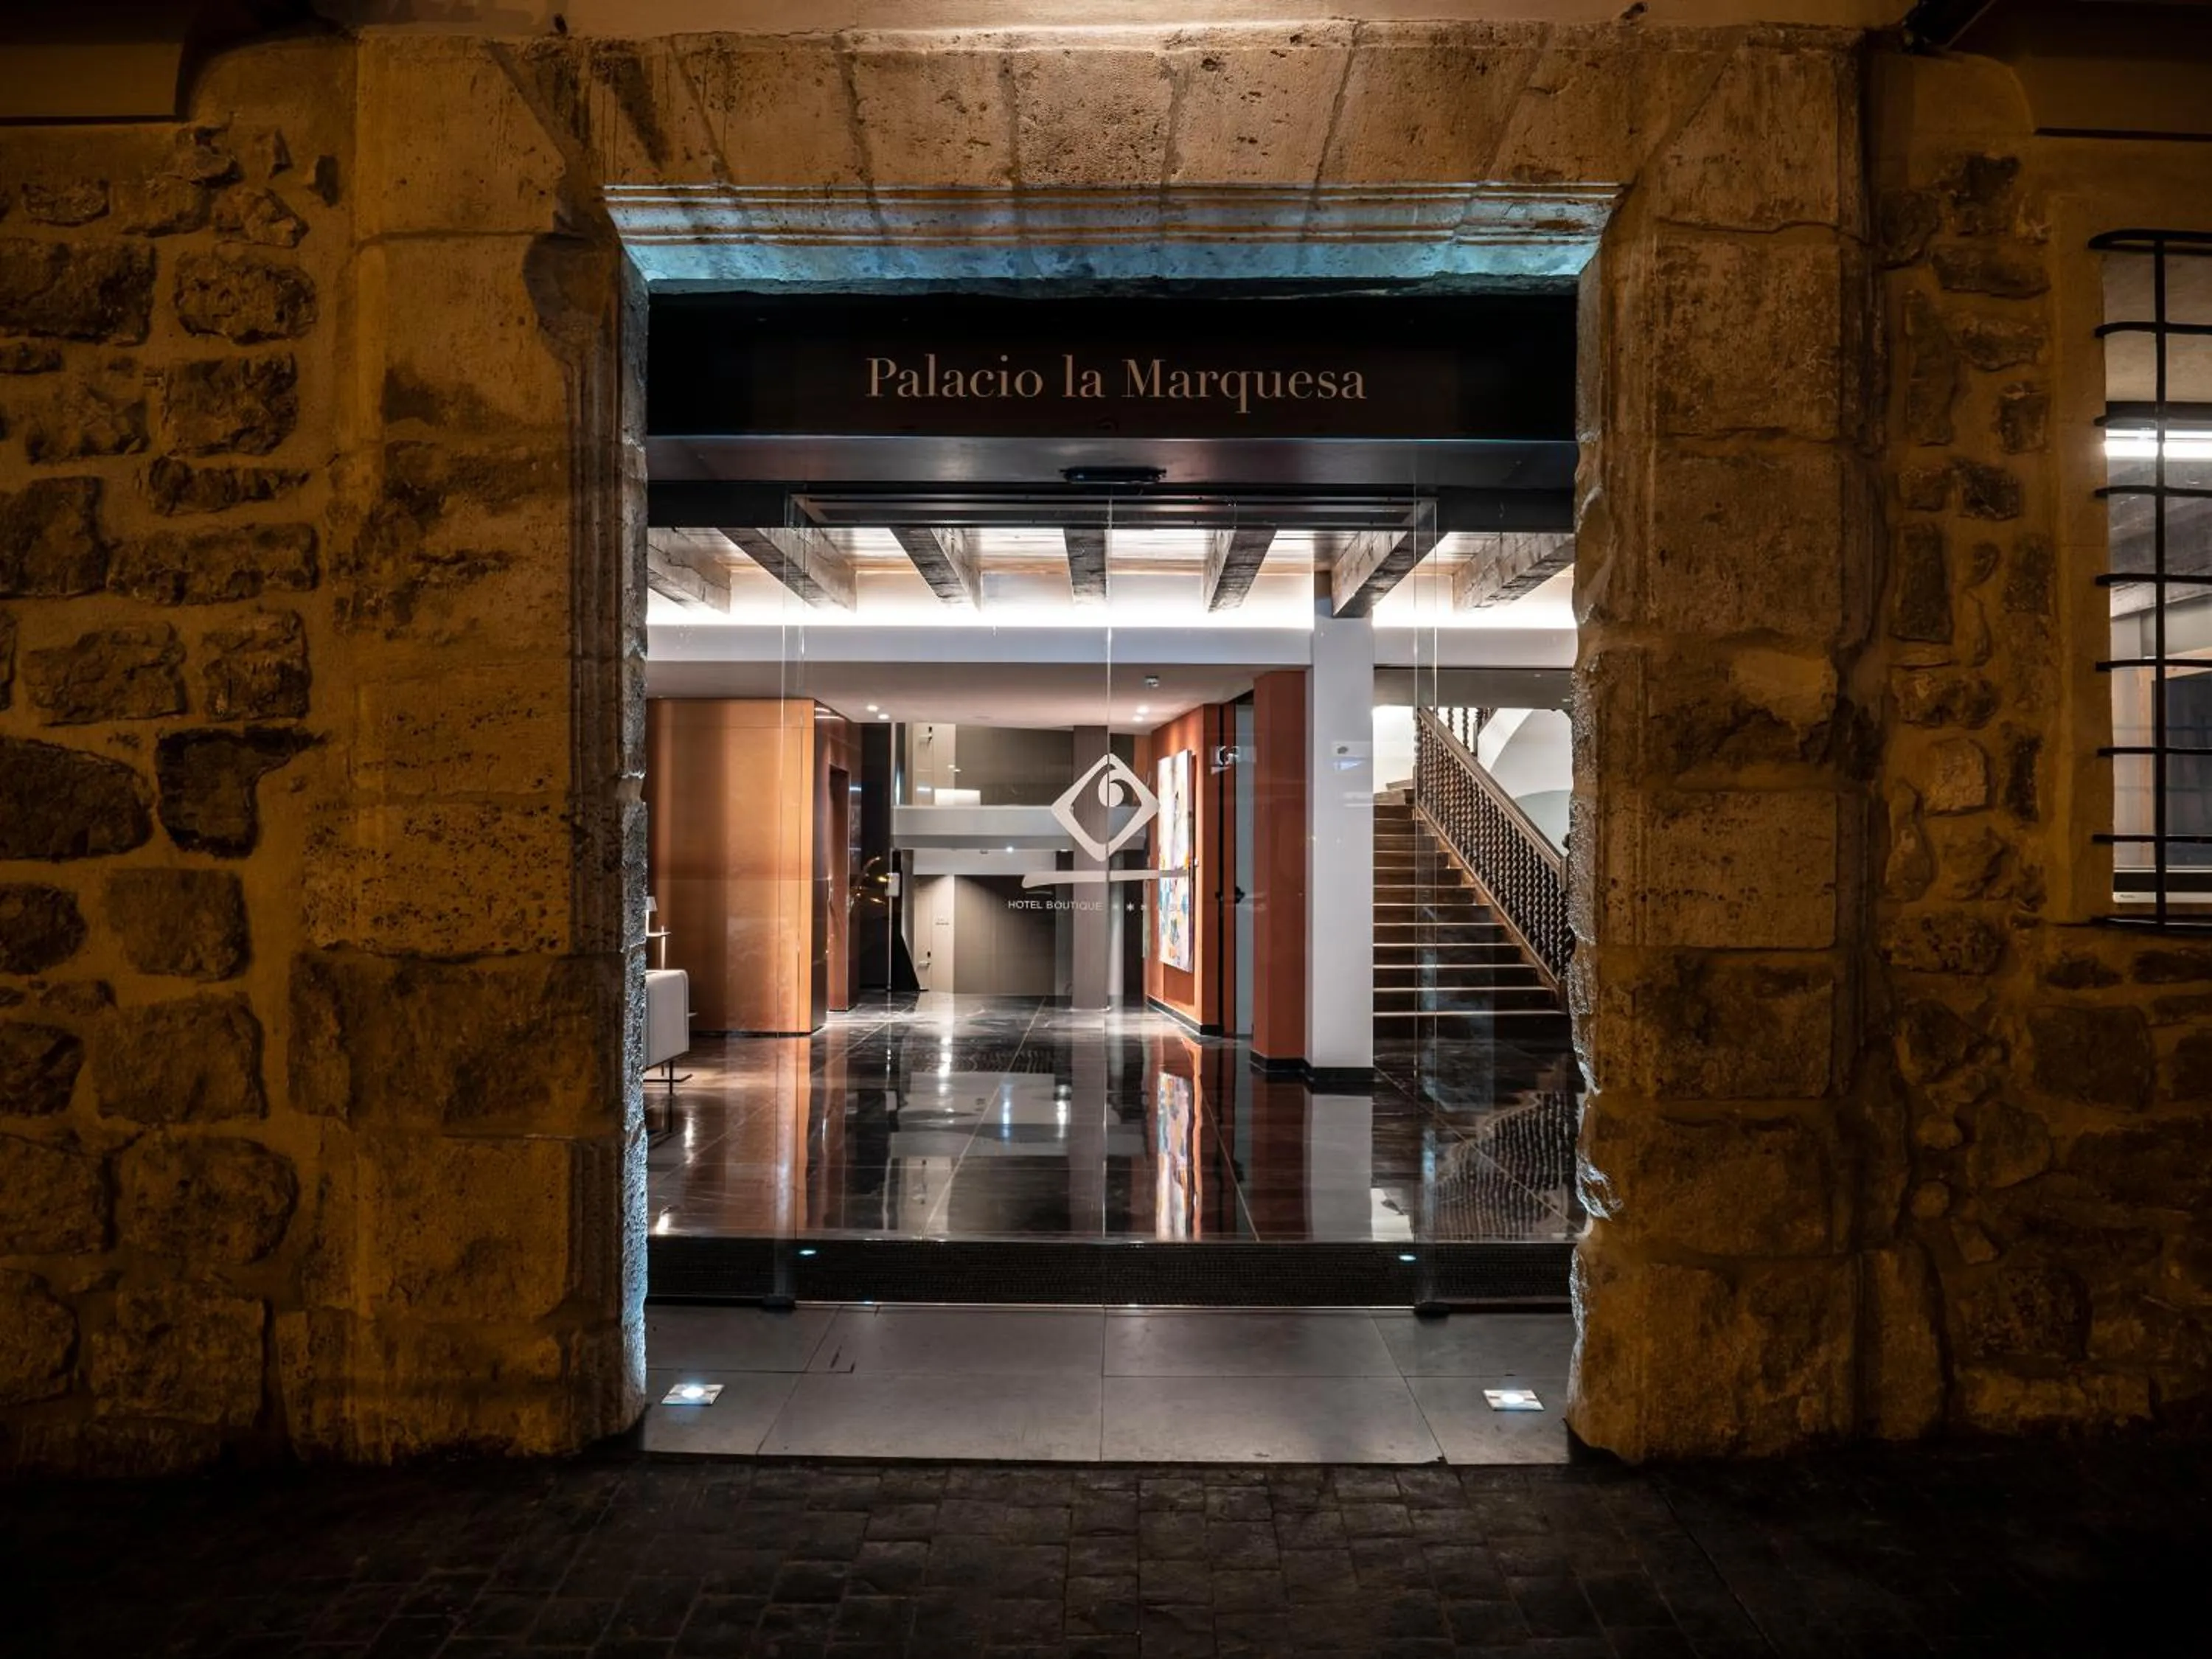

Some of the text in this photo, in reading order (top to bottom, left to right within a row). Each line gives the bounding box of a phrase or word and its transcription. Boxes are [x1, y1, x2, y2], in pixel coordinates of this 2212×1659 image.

[866, 354, 1368, 414] Palacio la Marquesa
[1007, 900, 1104, 911] HOTEL BOUTIQUE
